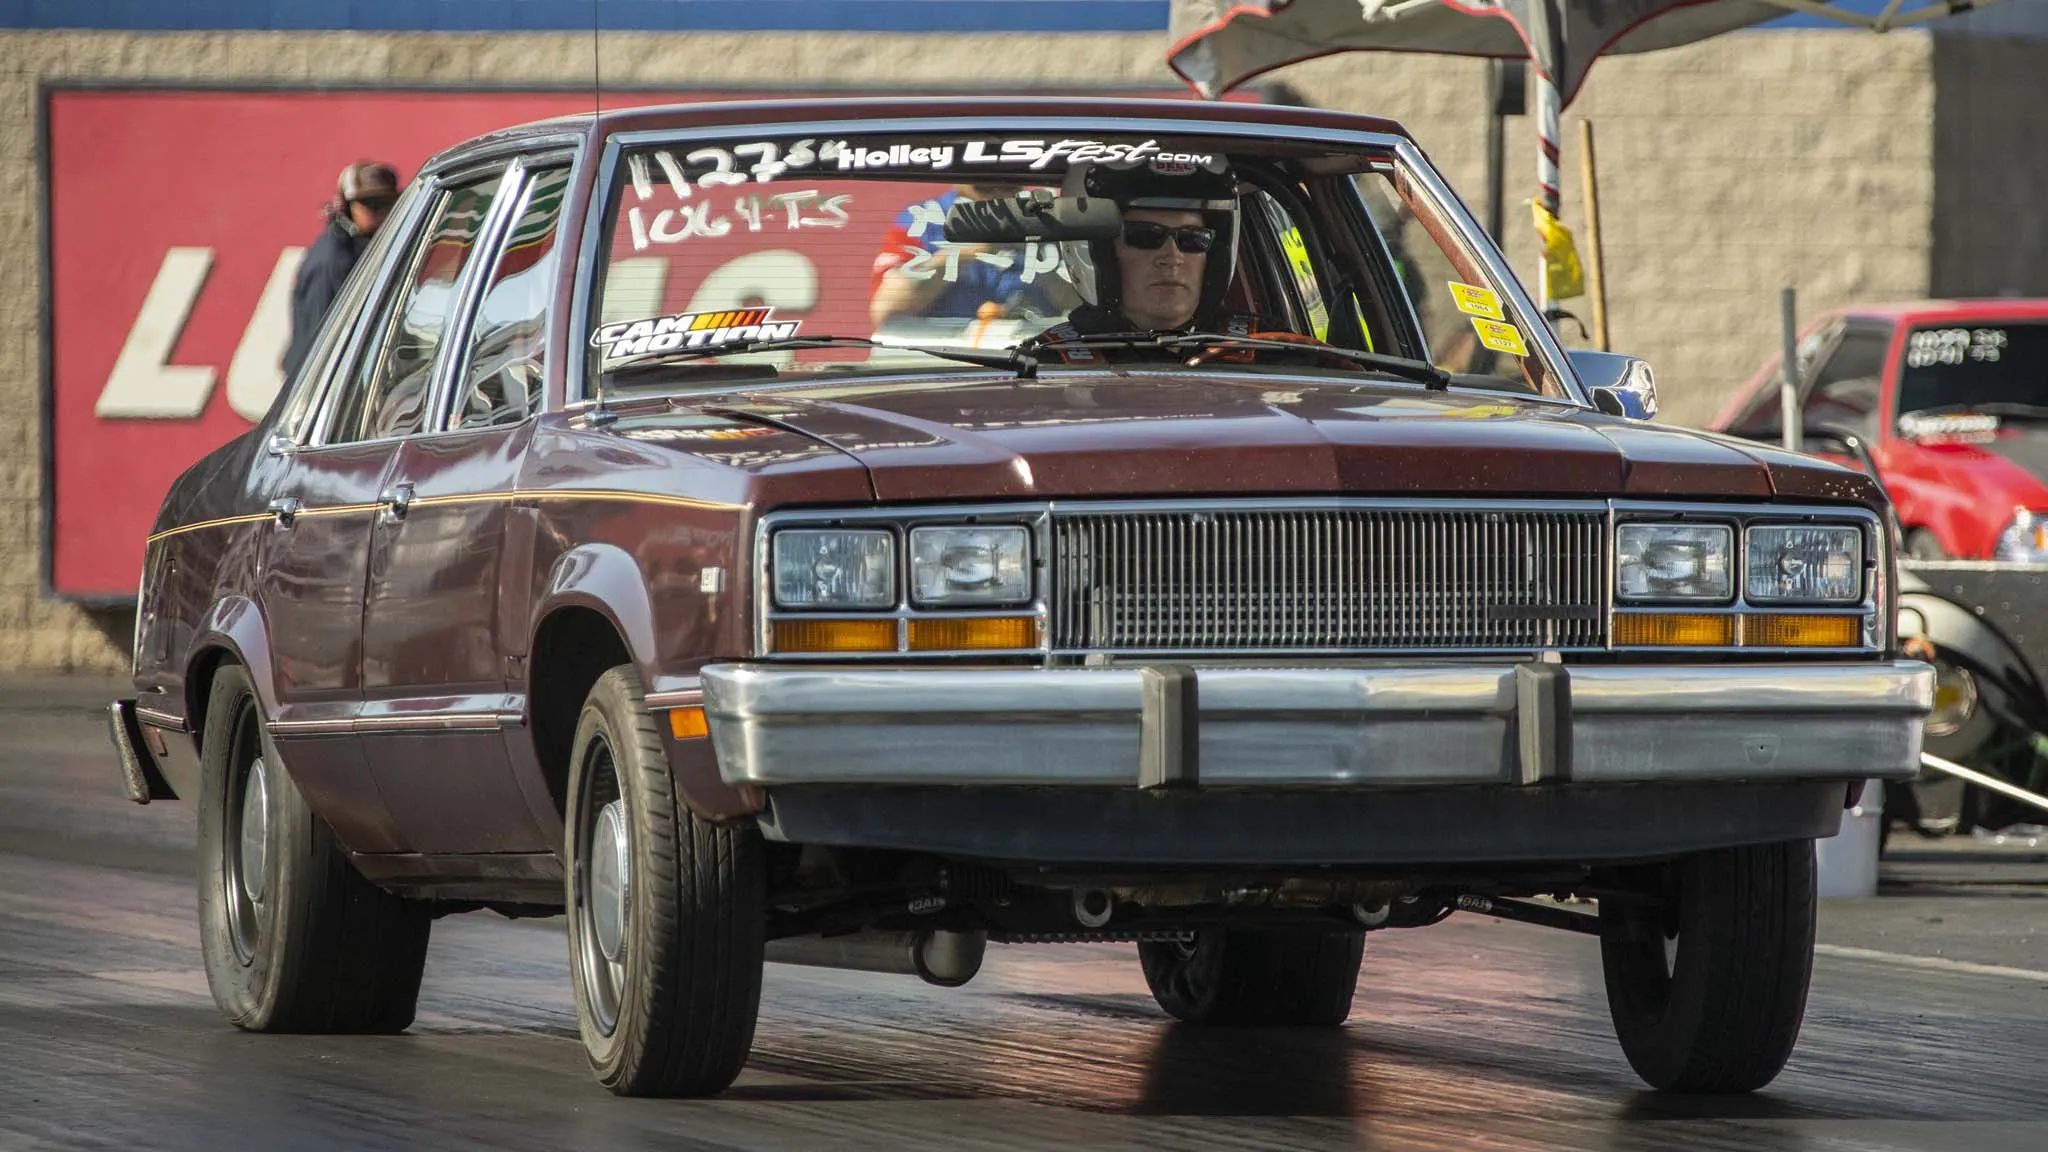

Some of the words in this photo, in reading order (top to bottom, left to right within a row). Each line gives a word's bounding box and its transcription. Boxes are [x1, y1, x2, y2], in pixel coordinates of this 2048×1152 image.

[837, 143, 956, 171] Holley
[600, 314, 695, 343] CAM
[609, 323, 794, 358] MOTION
